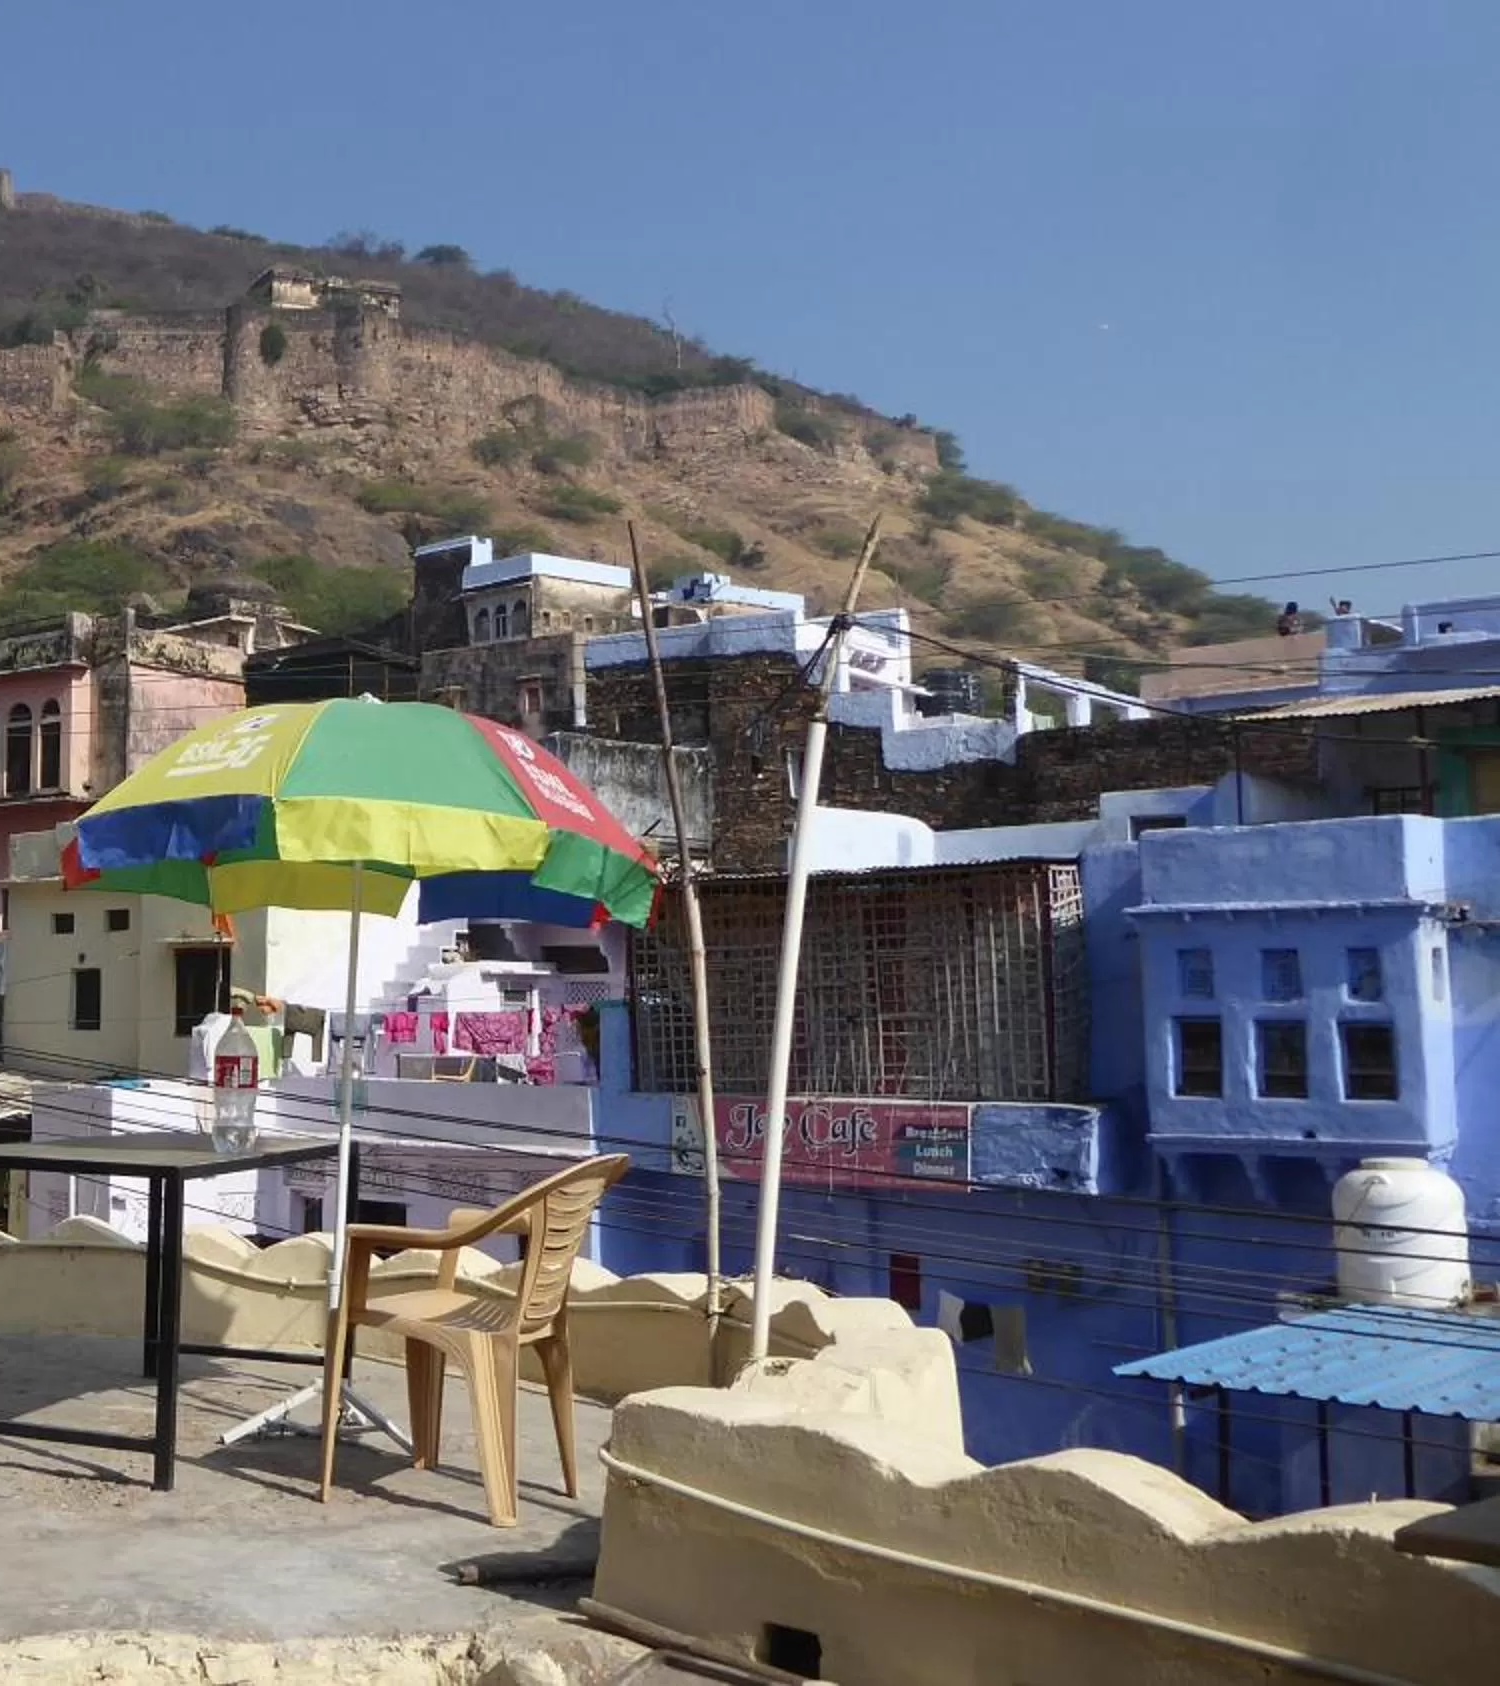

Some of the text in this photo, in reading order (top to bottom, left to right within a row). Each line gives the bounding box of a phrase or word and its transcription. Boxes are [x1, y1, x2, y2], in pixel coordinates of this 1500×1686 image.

[798, 1104, 877, 1159] Cafe
[915, 1143, 953, 1158] Lunch
[913, 1161, 955, 1176] Dinner
